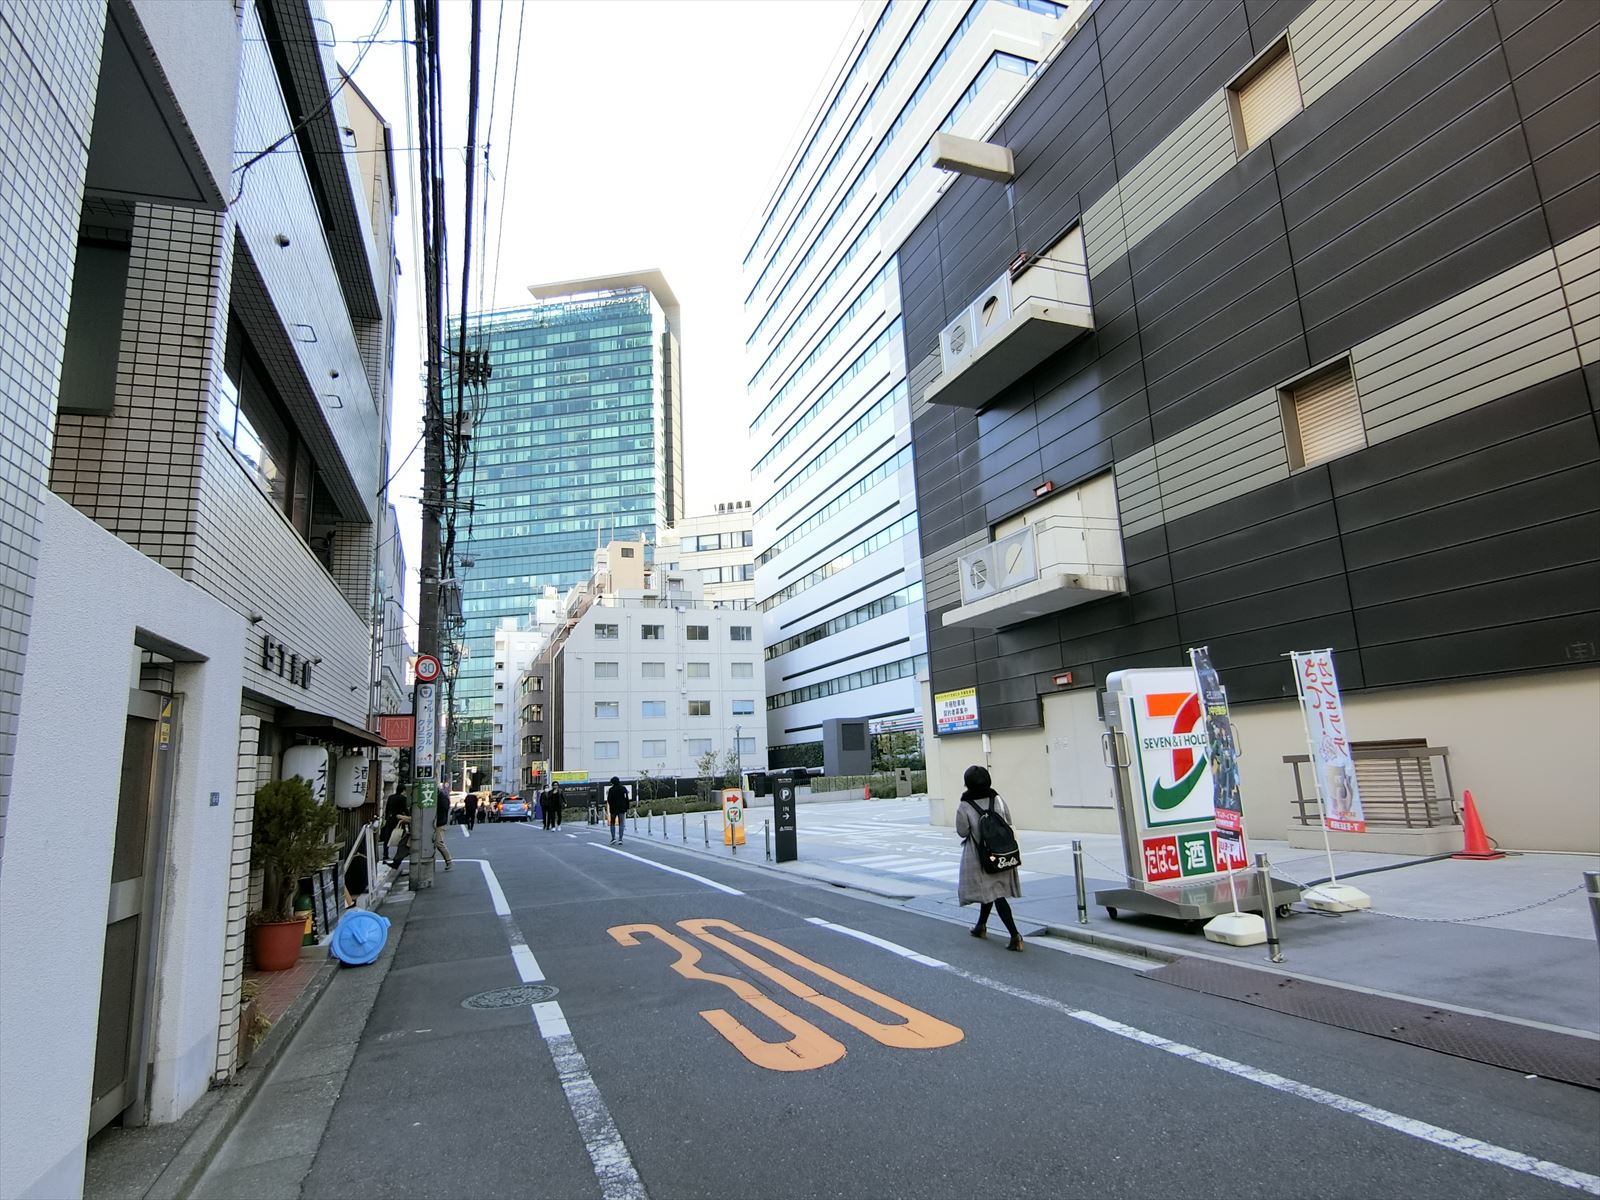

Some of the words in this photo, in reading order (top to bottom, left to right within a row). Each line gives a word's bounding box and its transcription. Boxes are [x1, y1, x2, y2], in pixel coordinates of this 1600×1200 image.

[420, 662, 435, 674] 30
[1145, 844, 1179, 875] たばこ
[1184, 839, 1207, 870] 酒
[606, 918, 966, 1072] 30
